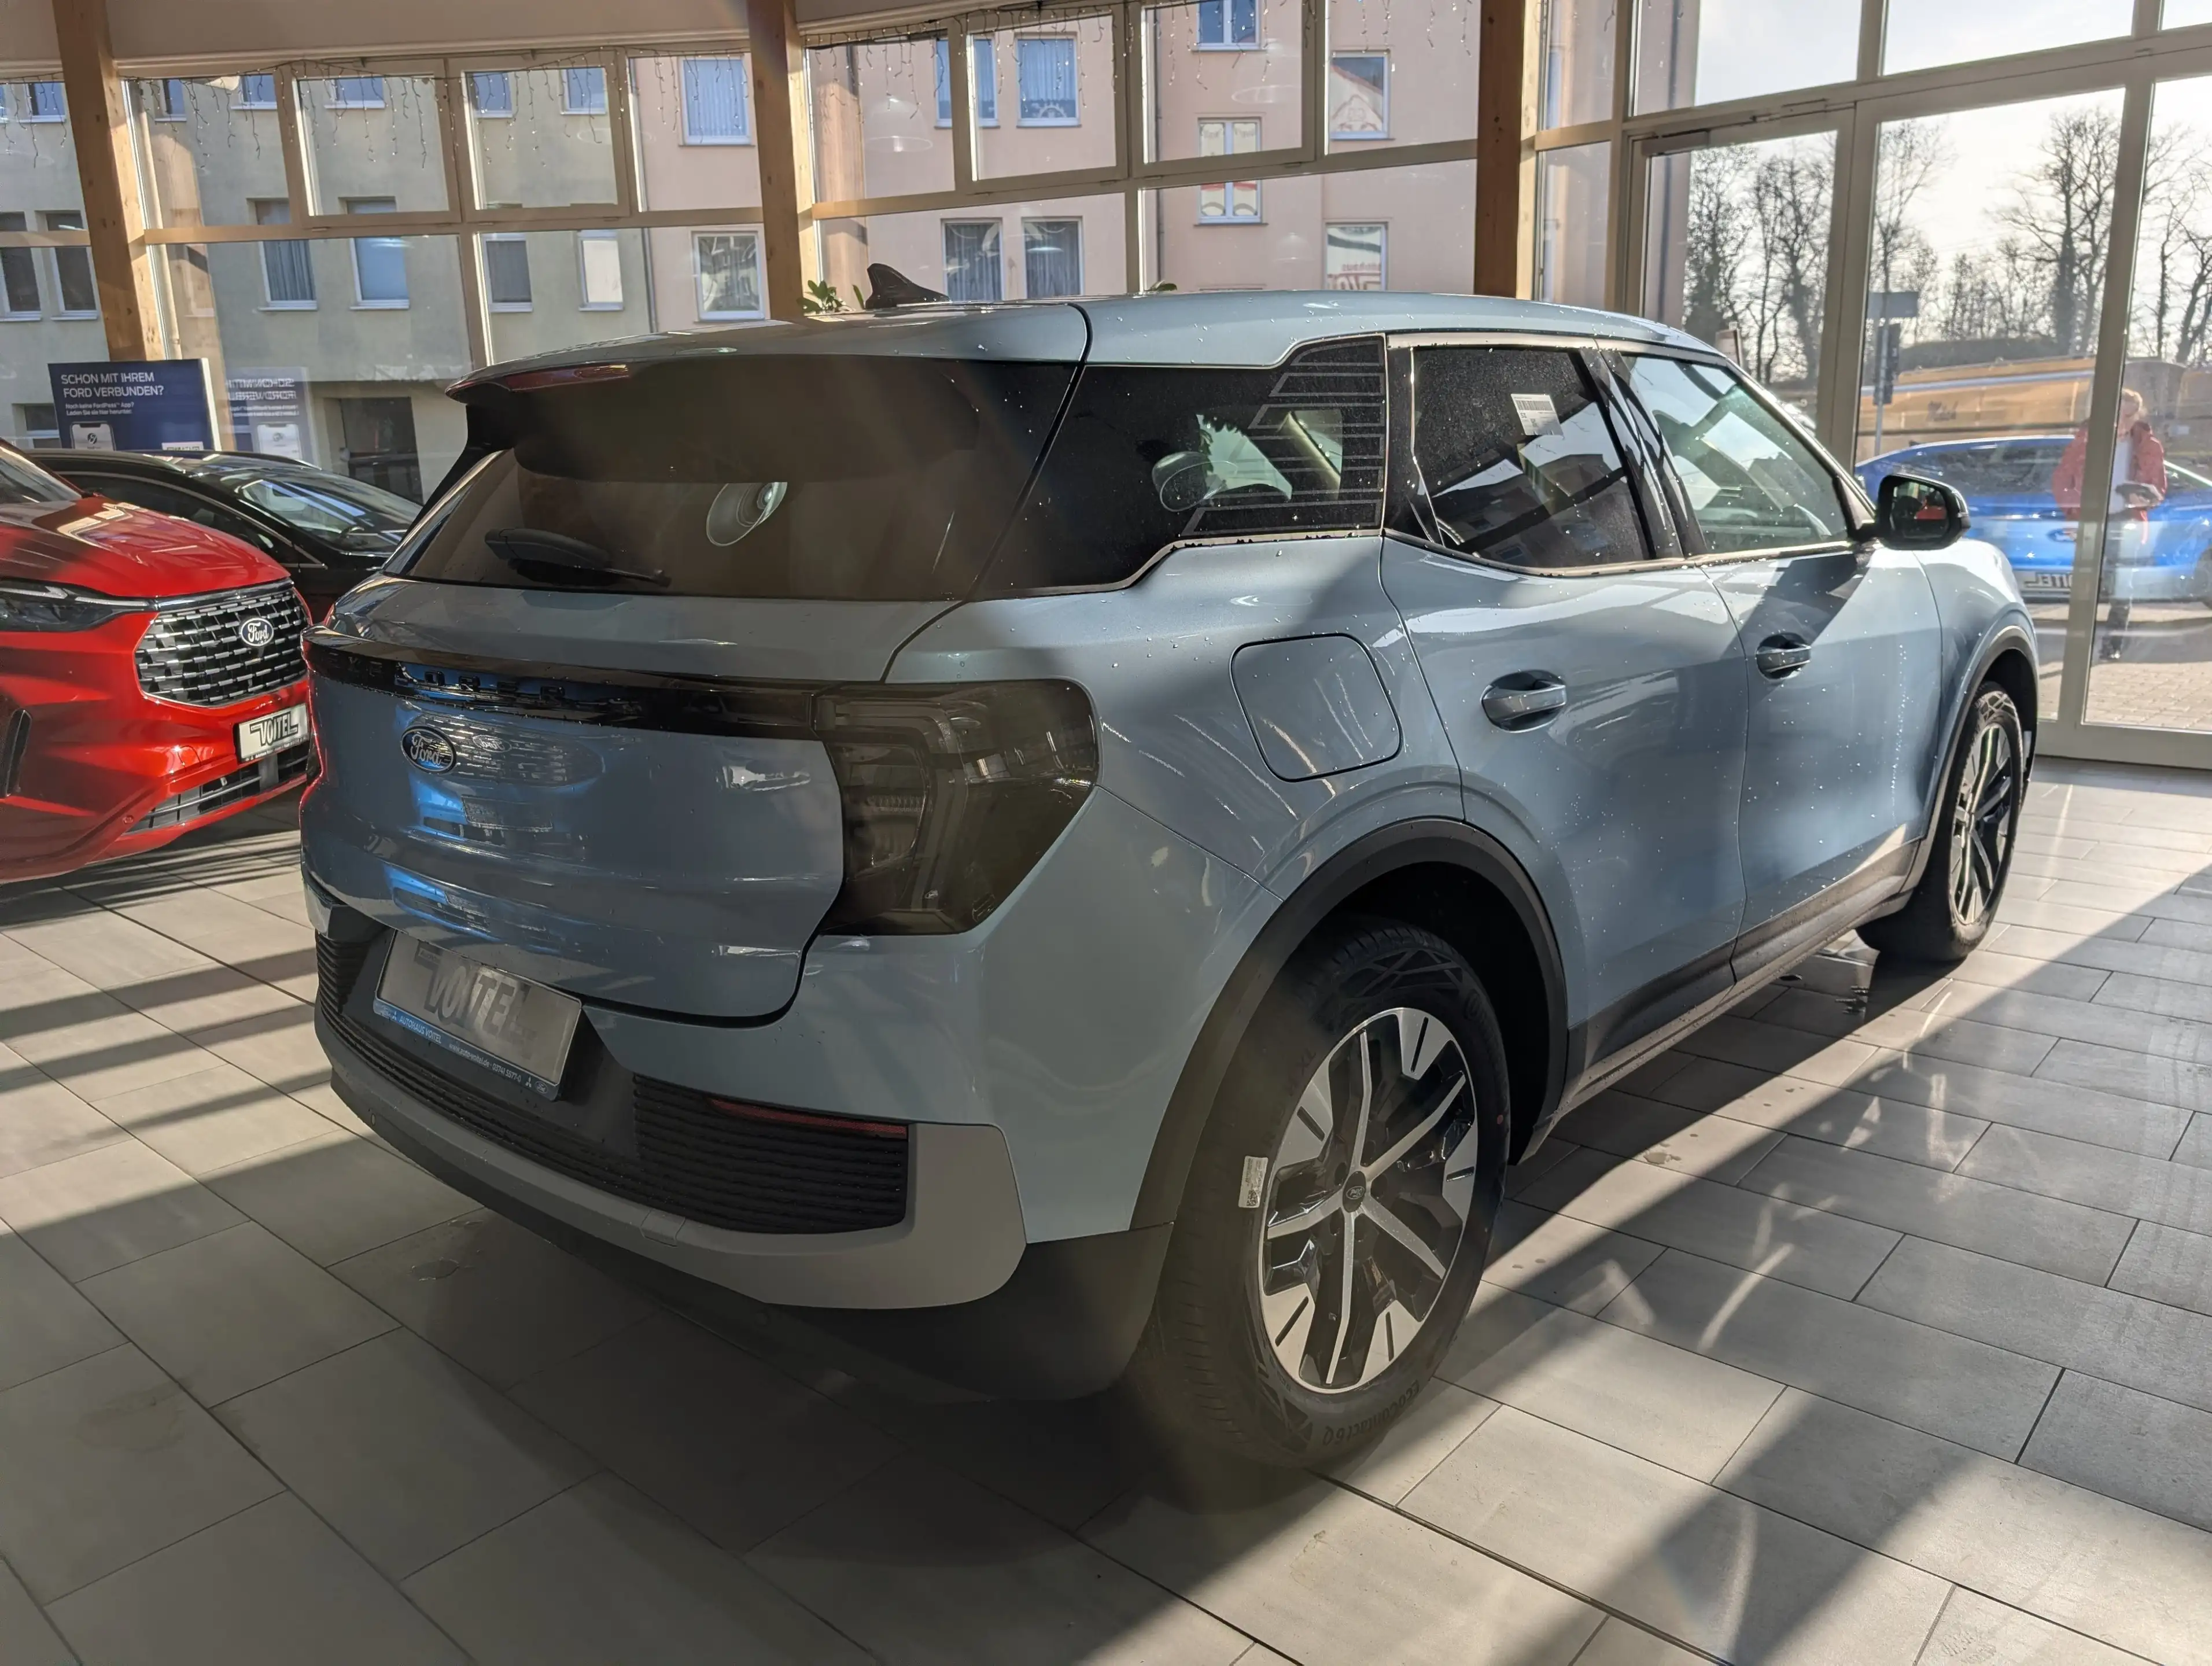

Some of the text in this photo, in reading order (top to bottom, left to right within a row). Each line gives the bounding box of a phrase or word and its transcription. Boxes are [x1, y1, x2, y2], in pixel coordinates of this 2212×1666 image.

[61, 372, 154, 384] SCHON MIT IHREM
[63, 385, 164, 398] FORD VERBUNDEN?
[248, 622, 270, 643] Ford
[250, 712, 298, 746] VOITEL
[410, 731, 443, 766] Ford
[415, 944, 537, 1059] VOITEL
[399, 1015, 425, 1034] AUTOHAUS
[425, 1028, 442, 1044] VOITEL
[492, 1063, 506, 1076] 03741
[1347, 1380, 1421, 1436] EcoContact
